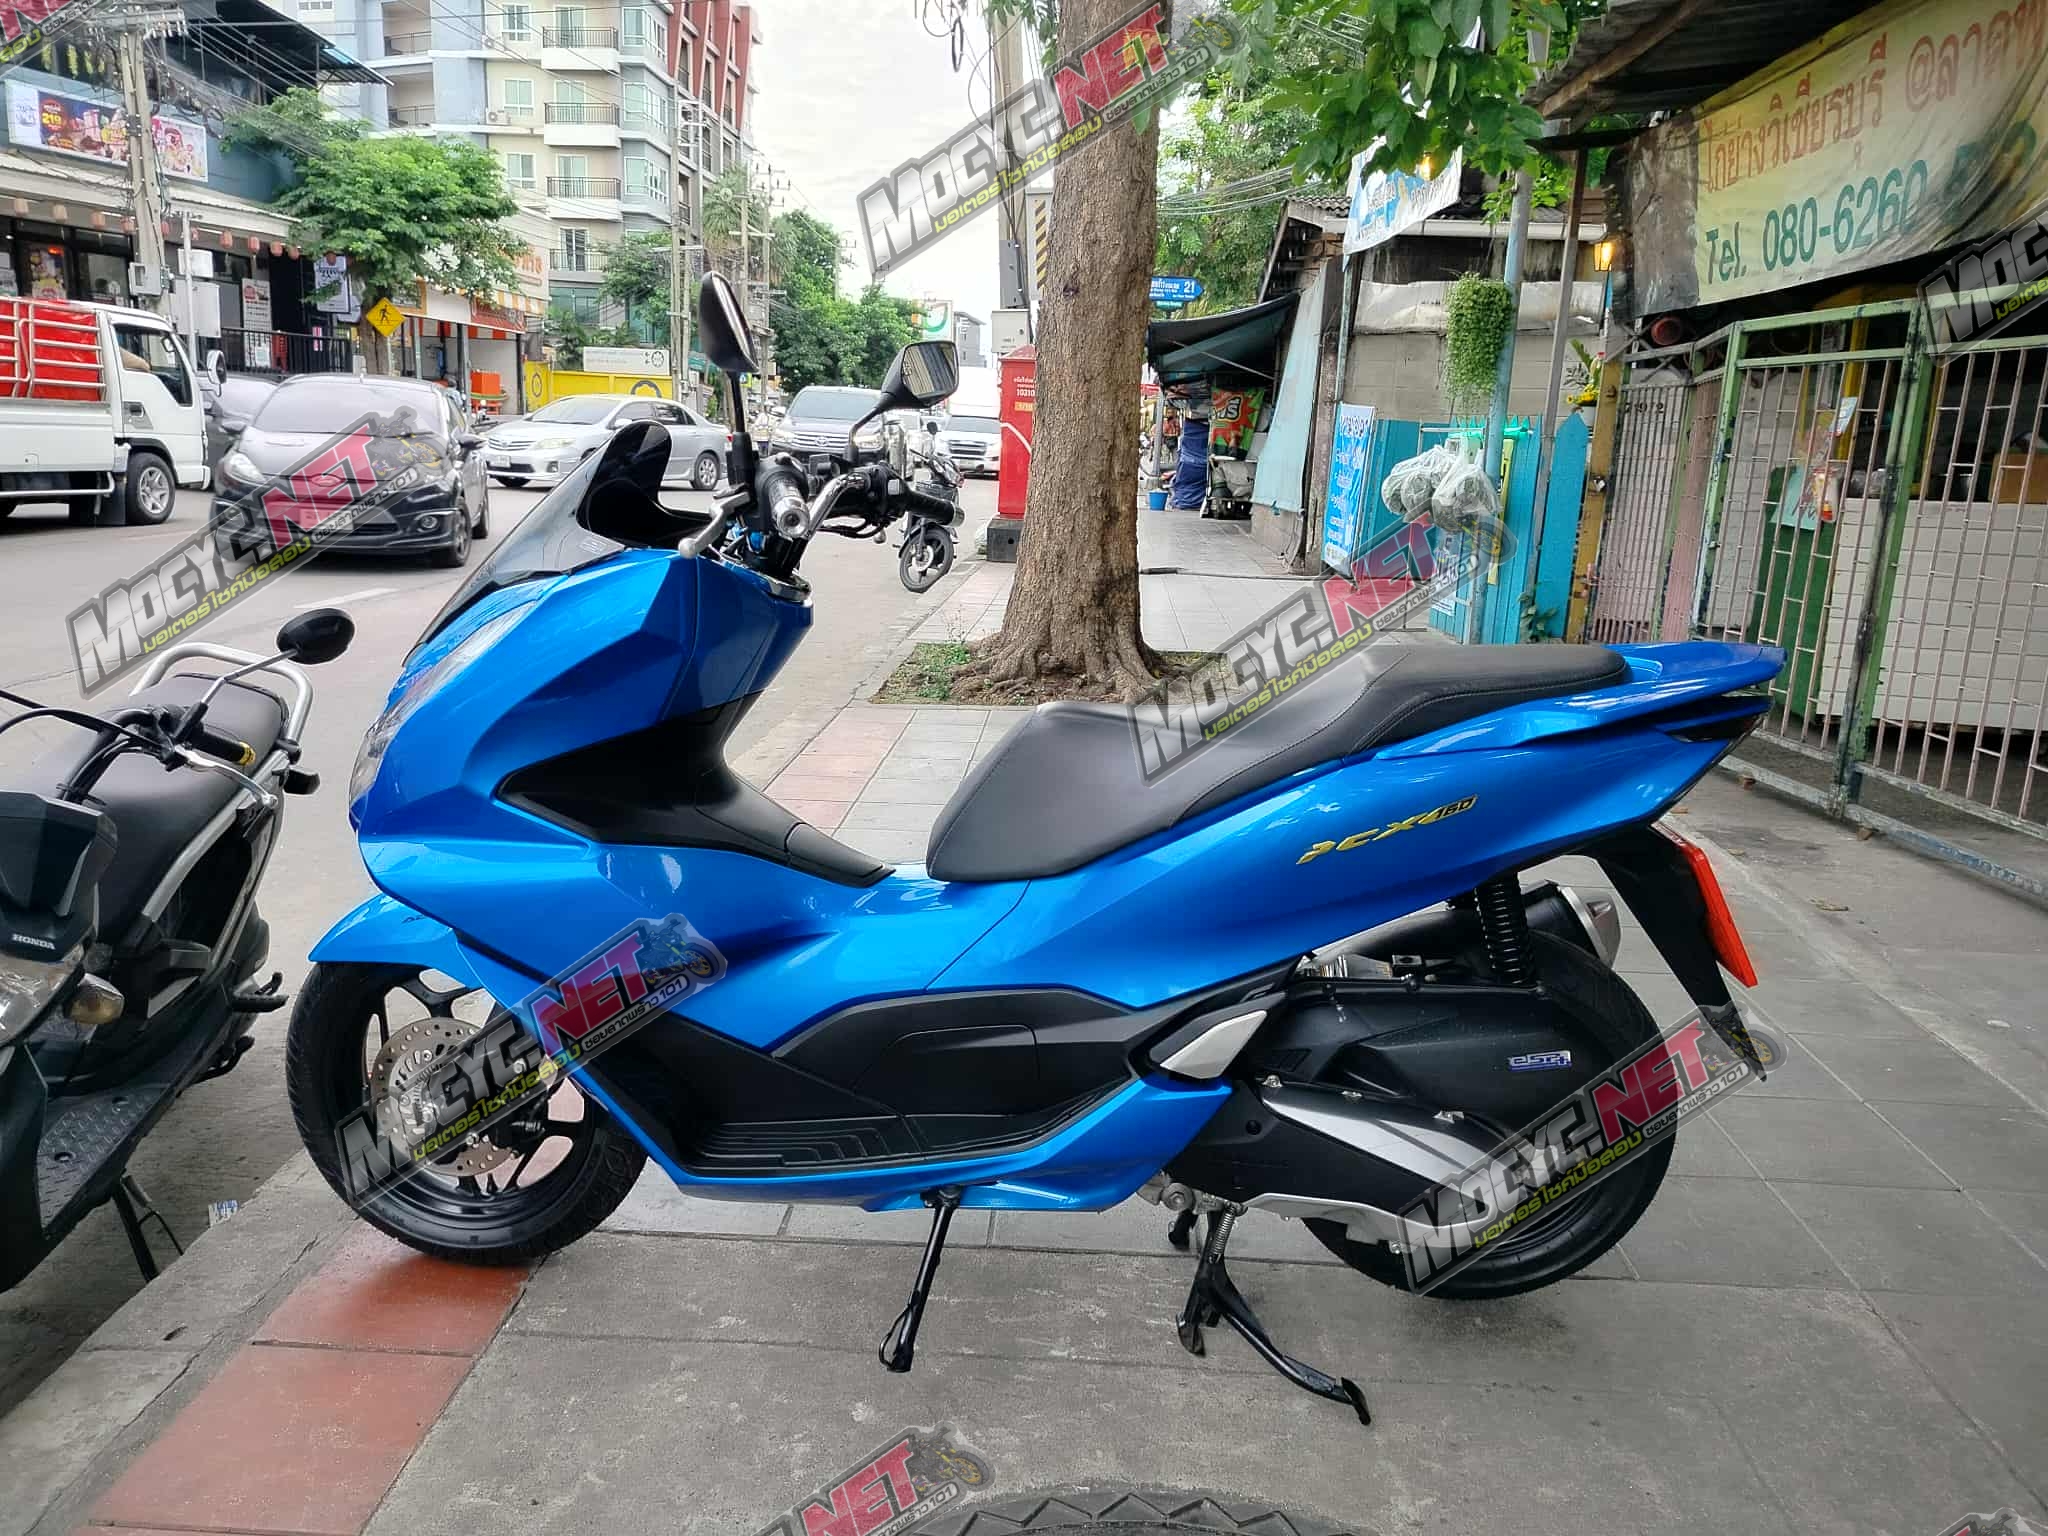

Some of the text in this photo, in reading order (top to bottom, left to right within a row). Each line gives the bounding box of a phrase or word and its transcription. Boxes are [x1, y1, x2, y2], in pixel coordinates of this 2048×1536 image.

[1706, 222, 1747, 284] Tel.
[1184, 281, 1195, 293] 21
[11, 933, 56, 950] HONDA
